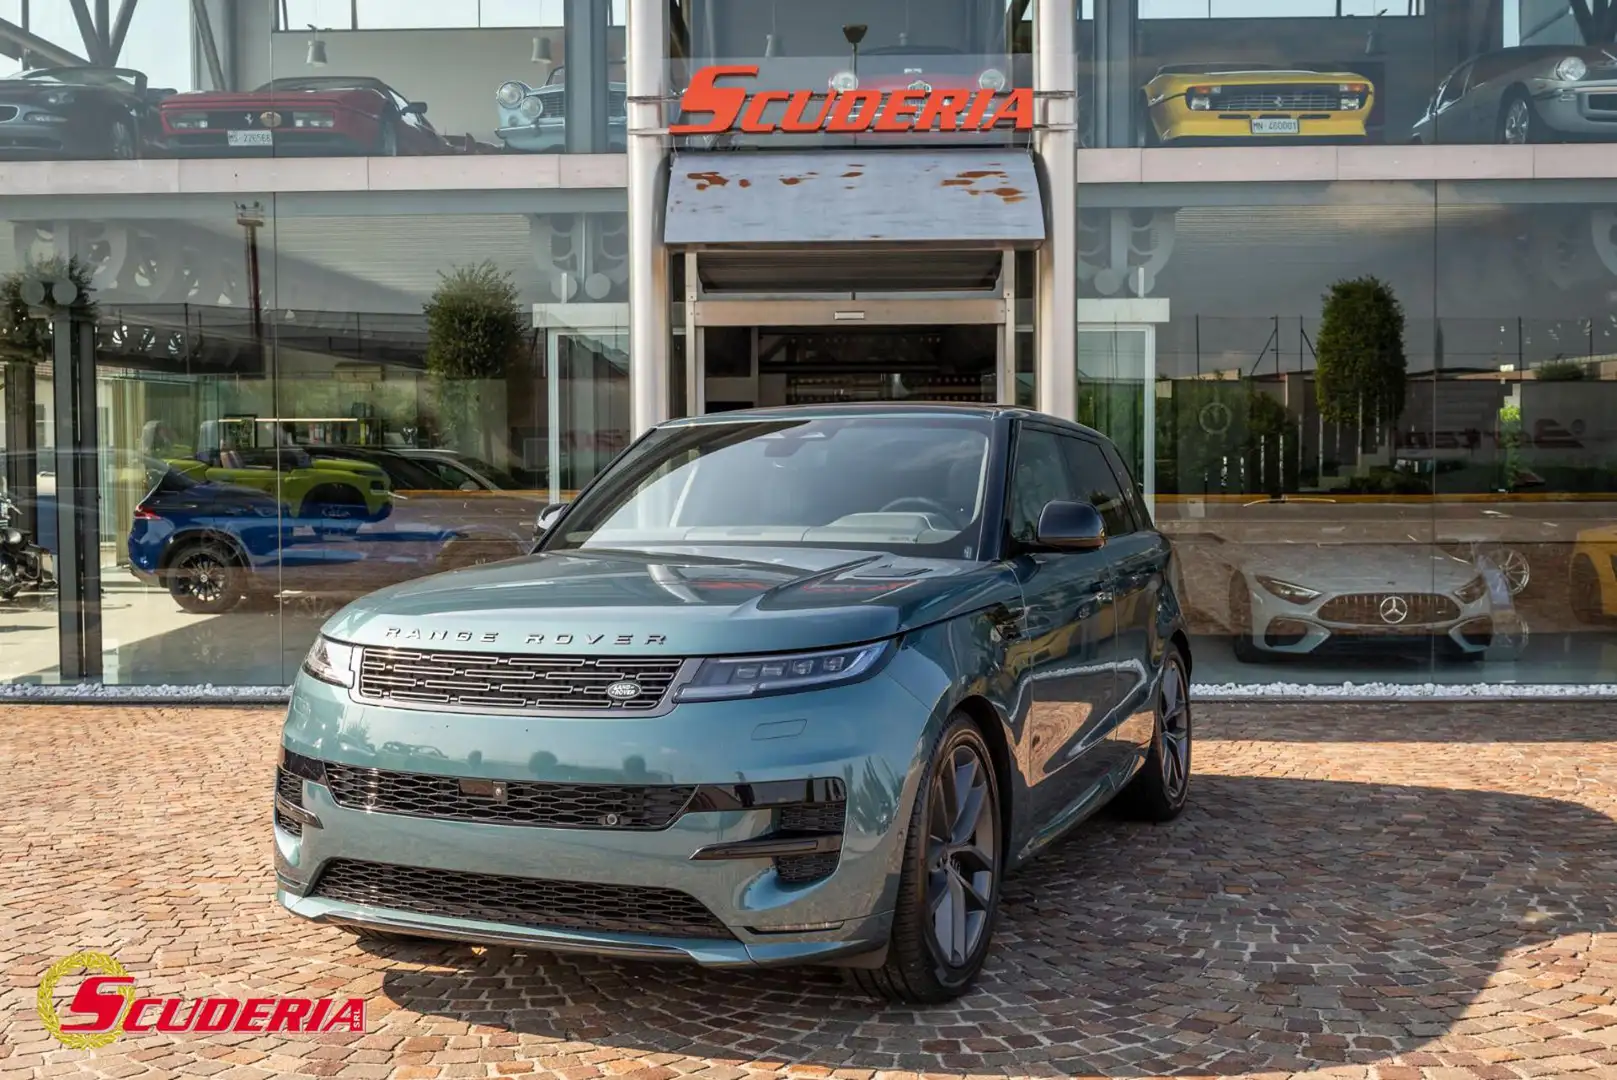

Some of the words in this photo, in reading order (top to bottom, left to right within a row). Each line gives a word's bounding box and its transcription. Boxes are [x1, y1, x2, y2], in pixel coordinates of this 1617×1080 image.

[669, 65, 1034, 134] SCUDERIA
[385, 627, 499, 643] RANGE
[524, 633, 667, 645] ROVER
